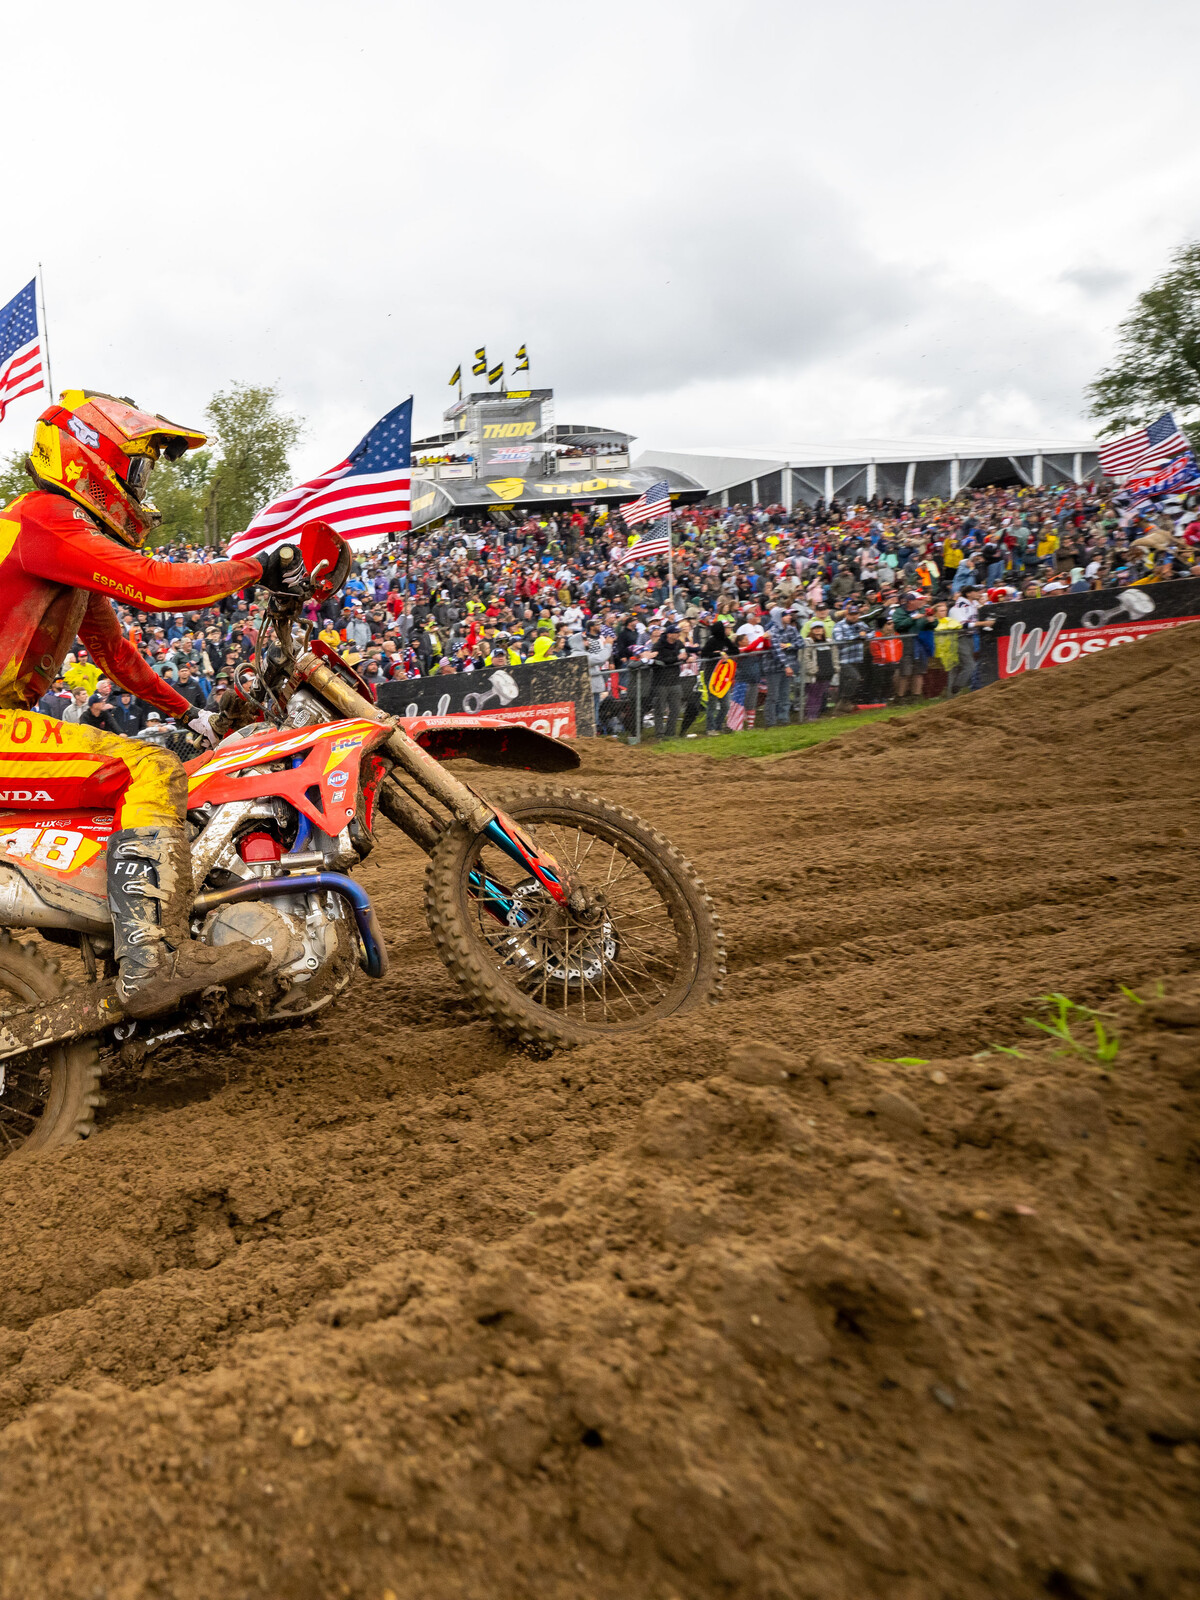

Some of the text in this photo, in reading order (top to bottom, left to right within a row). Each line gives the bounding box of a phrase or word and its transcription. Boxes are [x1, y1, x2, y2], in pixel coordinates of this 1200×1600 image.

[482, 421, 537, 439] THOR
[535, 478, 632, 494] THOR
[93, 571, 144, 602] ESPAÑA
[535, 706, 570, 717] PISTONS
[331, 735, 362, 752] HRC
[114, 862, 152, 878] FOX
